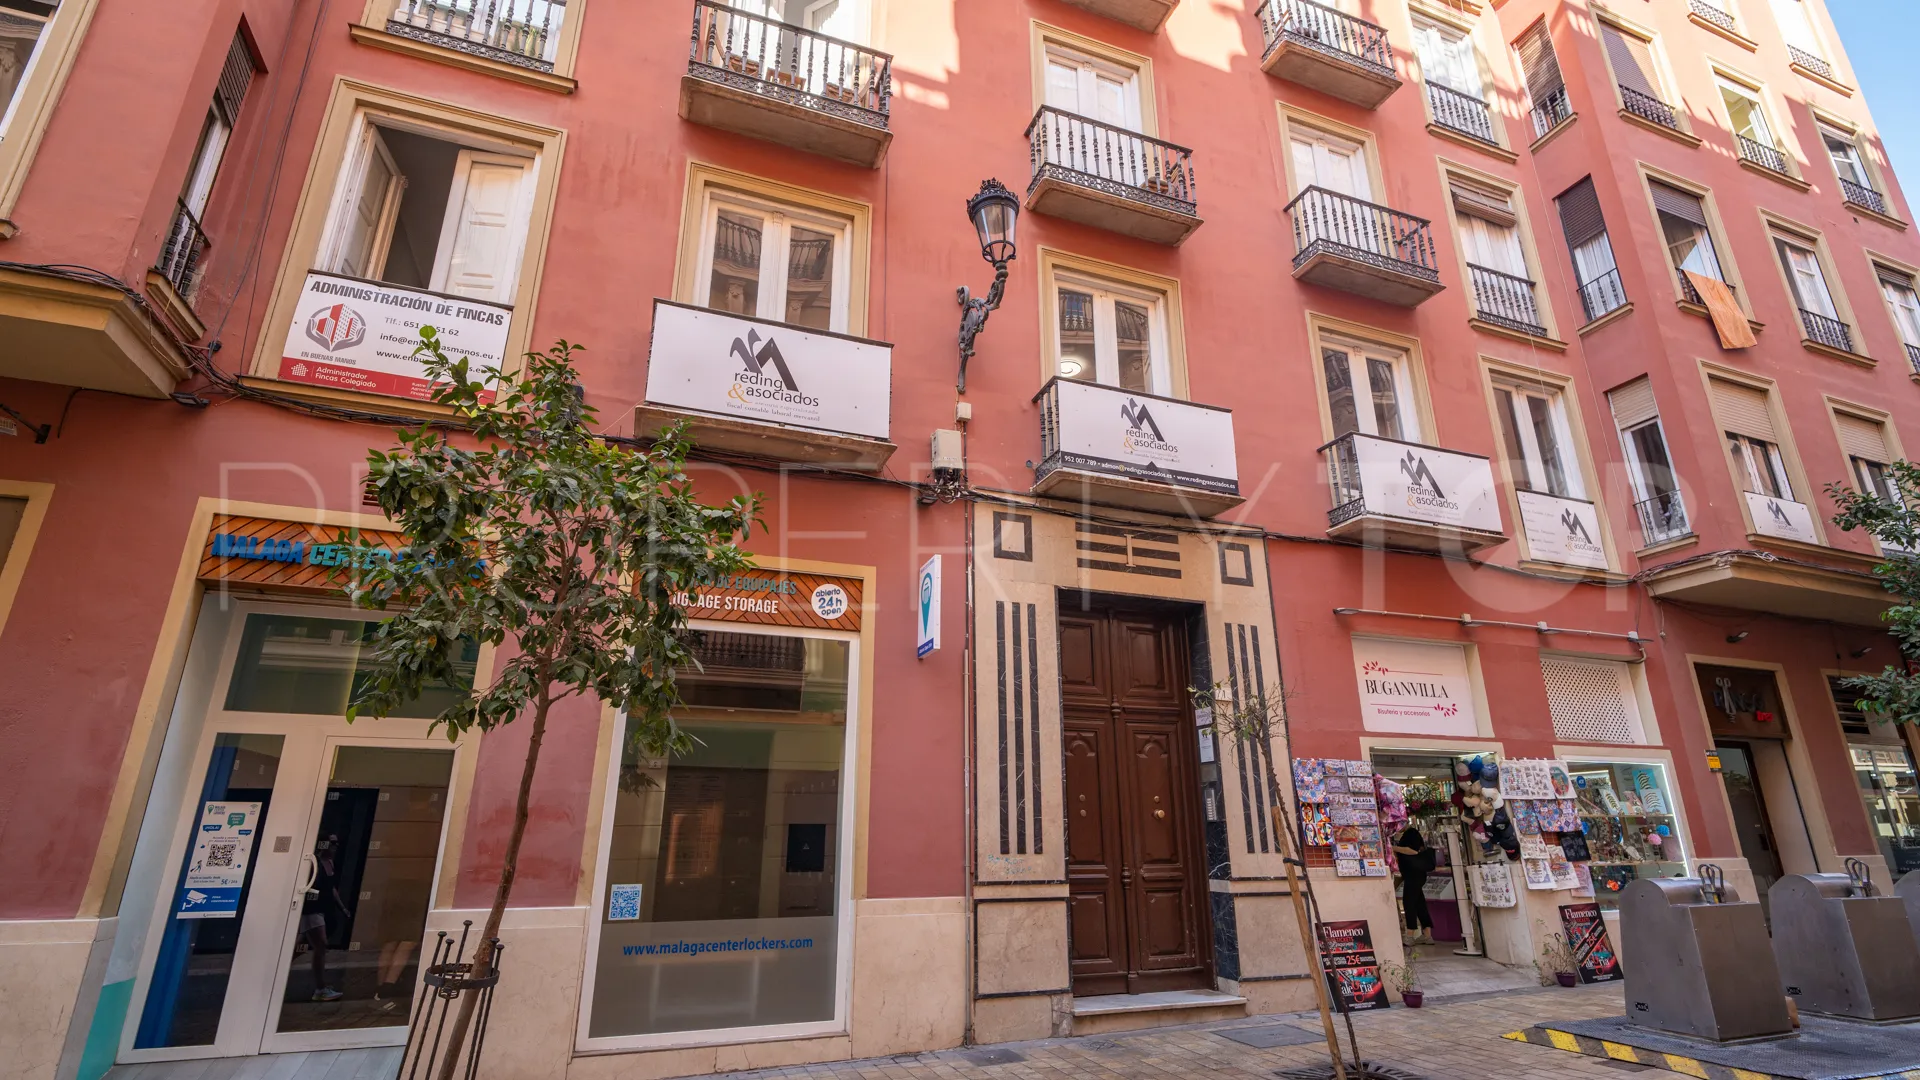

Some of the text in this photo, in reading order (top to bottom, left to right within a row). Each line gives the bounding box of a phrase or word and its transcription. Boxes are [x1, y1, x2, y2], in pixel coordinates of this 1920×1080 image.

[310, 280, 504, 326] ADMINISTRACIÓN DE FINCAS
[403, 320, 419, 329] 651
[448, 328, 459, 337] 62
[379, 332, 494, 360] info@enasmanos.eu
[301, 351, 357, 366] EN BUENAS MANOS
[315, 373, 377, 388] Fincas Colegiado
[316, 366, 368, 380] Administrador
[734, 371, 783, 391] reding
[746, 384, 819, 407] asociados
[744, 405, 769, 414] contable
[771, 409, 792, 417] laboral
[794, 414, 820, 422] mercantil
[1126, 428, 1155, 442] reding
[1133, 438, 1179, 453] asociados
[1086, 458, 1097, 466] 789
[1176, 475, 1236, 489] www.redingyasociados.es
[1407, 484, 1436, 499] reding
[1416, 496, 1459, 511] asociados
[1567, 535, 1587, 543] reding
[210, 533, 304, 564] MALAGA
[715, 574, 732, 589] DE
[735, 575, 798, 595] EQUIPAJES
[815, 588, 841, 598] abierto
[724, 597, 779, 614] STORAGE
[821, 607, 842, 616] open
[1365, 679, 1449, 699] BUGANVILLA
[1564, 908, 1598, 920] Flamenco
[1323, 926, 1364, 938] Flamenco
[622, 936, 813, 956] www.malagacenterlockers.com
[1346, 954, 1361, 965] 25€
